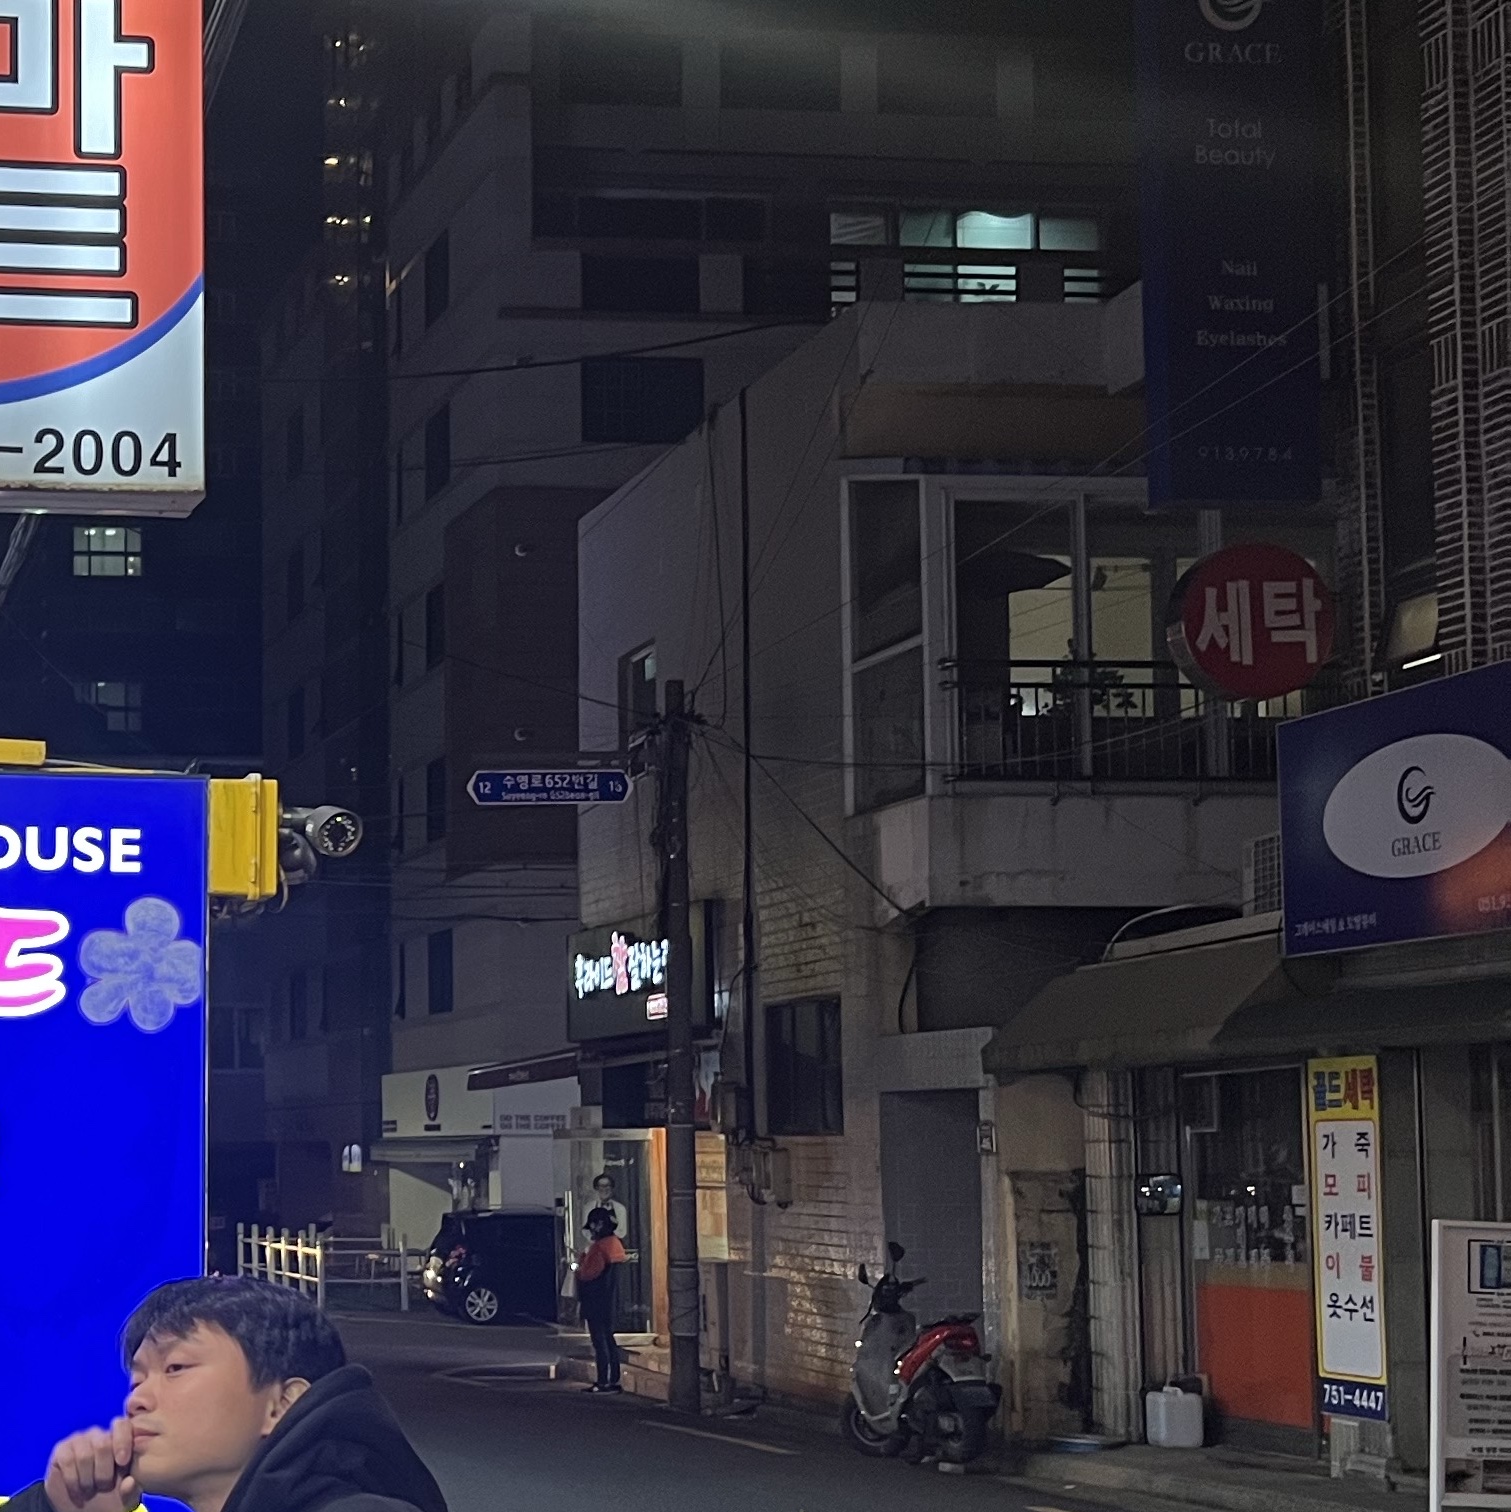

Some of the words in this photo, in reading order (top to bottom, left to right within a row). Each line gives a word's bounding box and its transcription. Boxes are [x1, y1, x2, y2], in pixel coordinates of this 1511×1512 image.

[1184, 42, 1282, 65] GRACE
[1207, 118, 1263, 139] Total
[1194, 145, 1277, 170] Beauty
[1222, 260, 1257, 277] Nail
[1208, 296, 1274, 314] Waxing
[1195, 330, 1288, 347] Eyelashes
[1196, 577, 1323, 666] 세탁
[479, 782, 491, 793] 12
[1391, 831, 1442, 858] GRACE
[1324, 1212, 1374, 1240] 카페트
[1327, 1292, 1375, 1323] 옷수선
[1323, 1383, 1384, 1412] 751-4447
